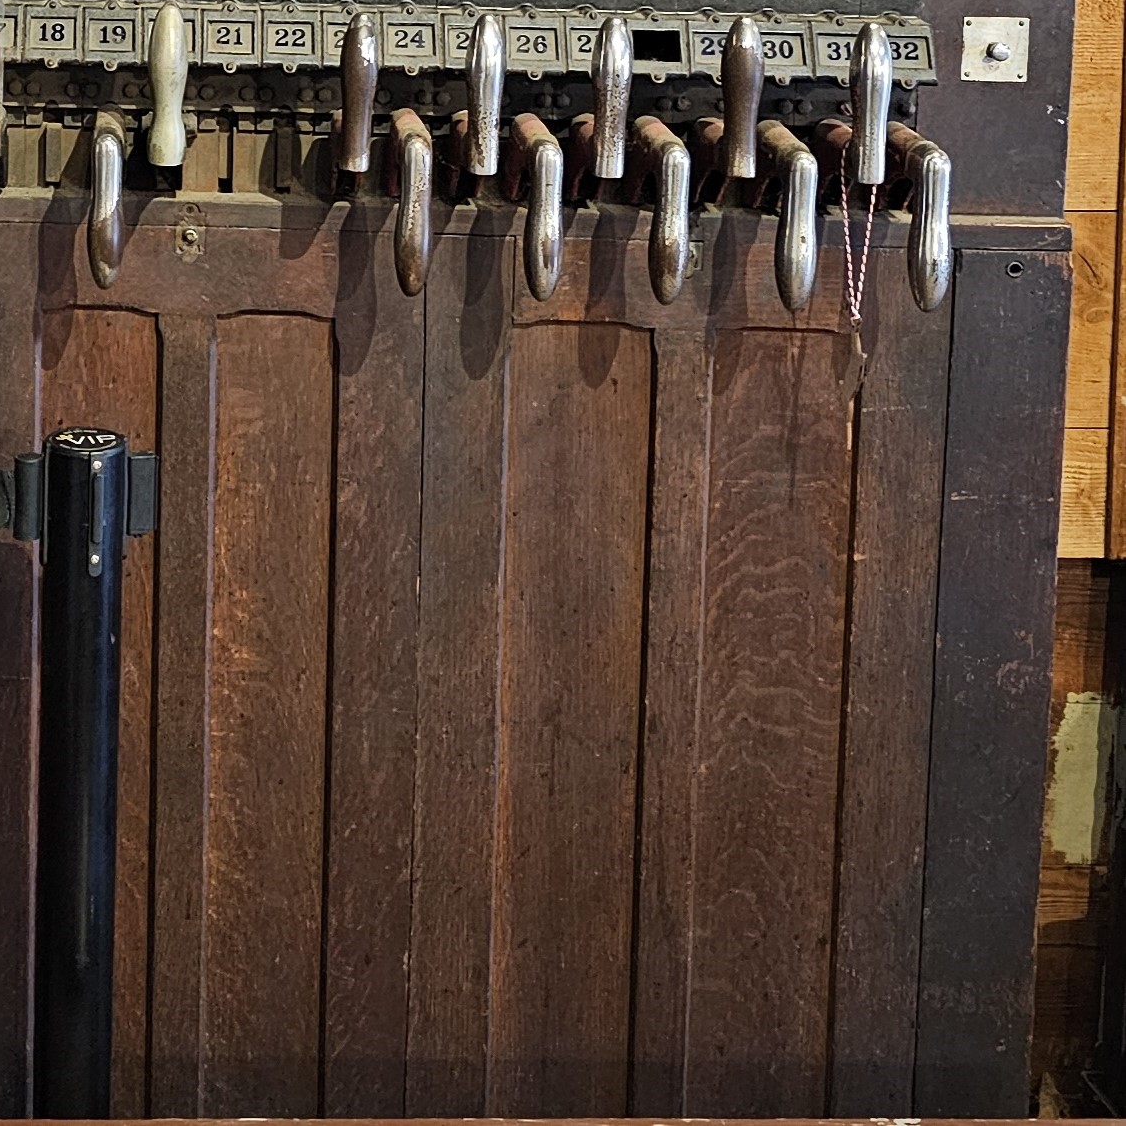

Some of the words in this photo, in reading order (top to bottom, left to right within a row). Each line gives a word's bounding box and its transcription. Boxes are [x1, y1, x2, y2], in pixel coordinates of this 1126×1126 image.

[38, 23, 65, 42] 18
[99, 25, 127, 44] 19
[216, 26, 243, 46] 21
[274, 28, 306, 48] 22
[394, 29, 426, 49] 24
[516, 34, 548, 54] 26
[763, 39, 794, 59] 30
[826, 41, 852, 61] 31
[891, 41, 920, 61] 32
[66, 434, 116, 445] VIP
